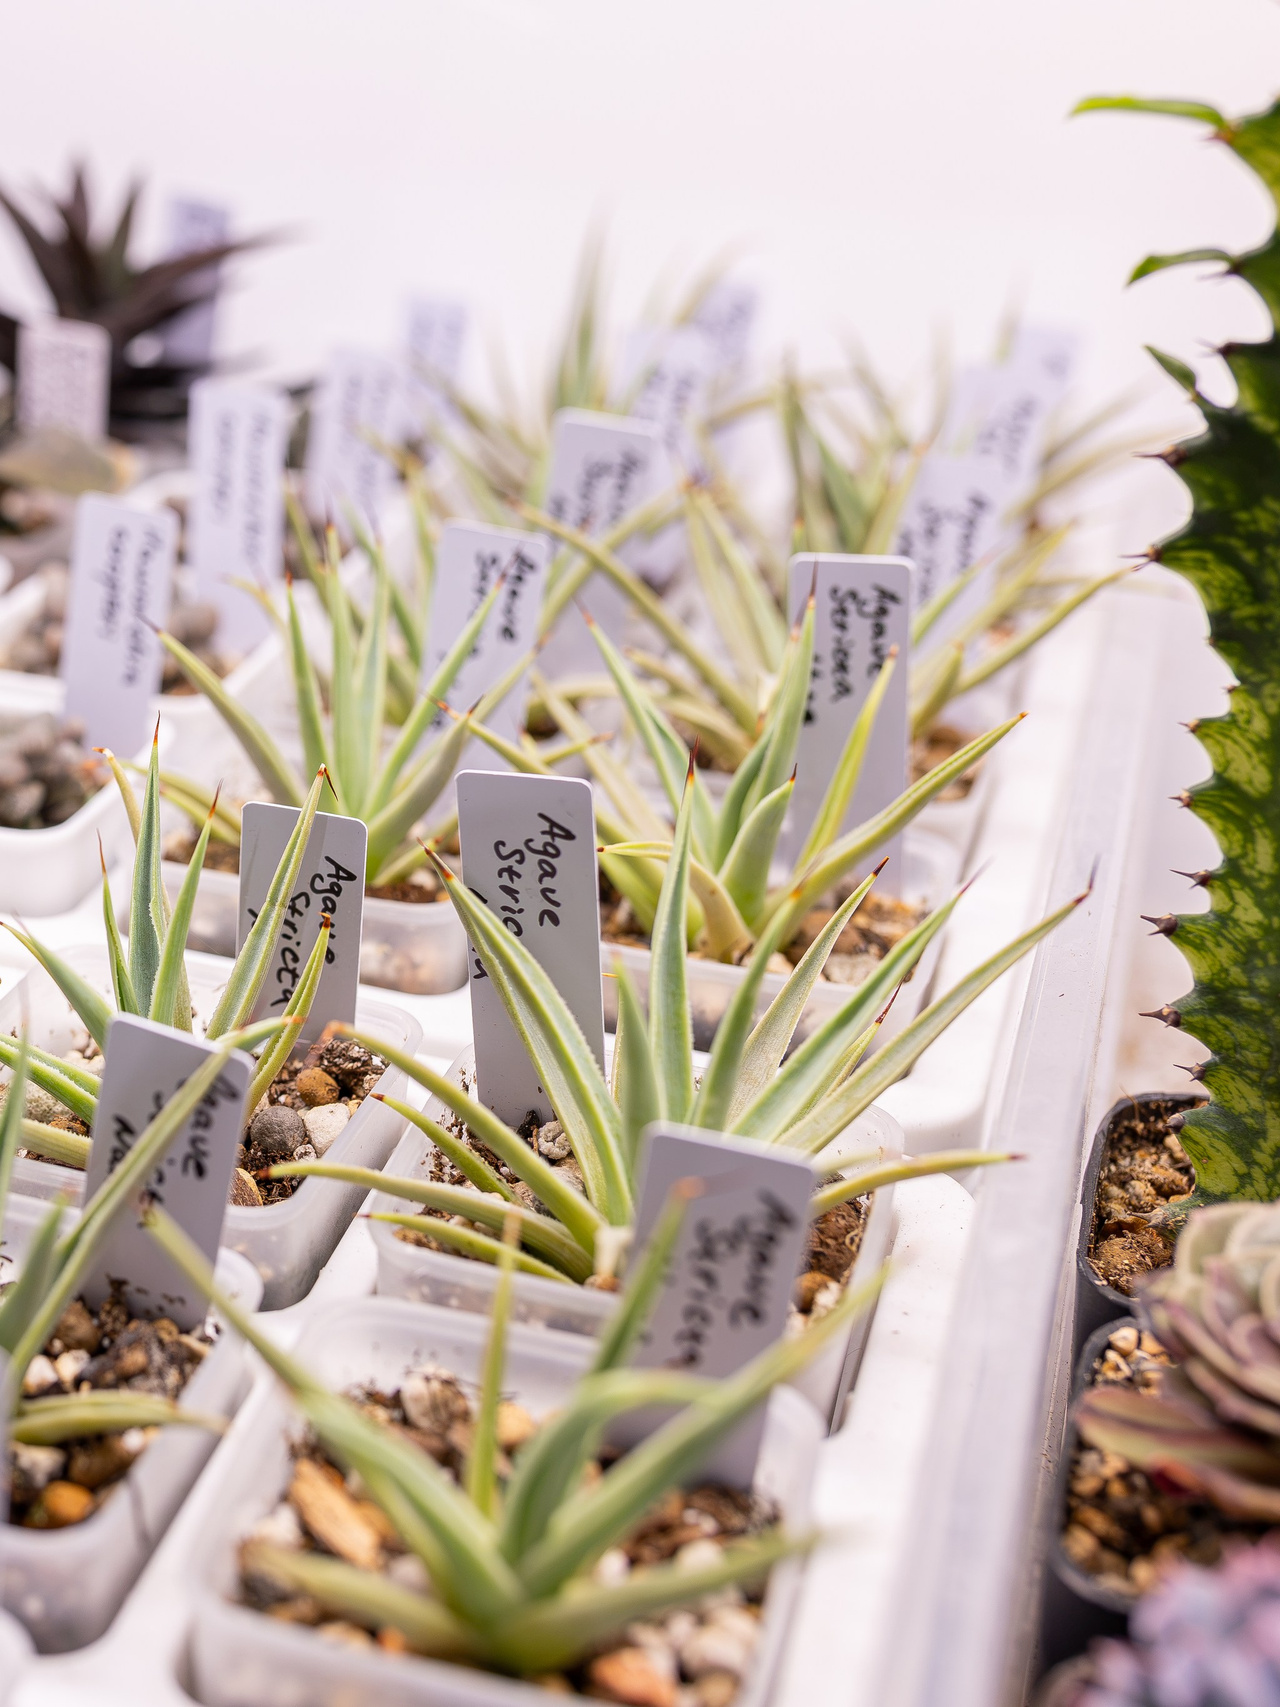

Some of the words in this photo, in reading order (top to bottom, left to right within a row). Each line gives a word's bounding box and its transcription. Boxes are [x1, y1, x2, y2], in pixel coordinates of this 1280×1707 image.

[856, 583, 902, 679] Agave
[494, 840, 526, 938] Stric
[524, 812, 577, 928] Agave
[269, 891, 311, 1007] Stricta
